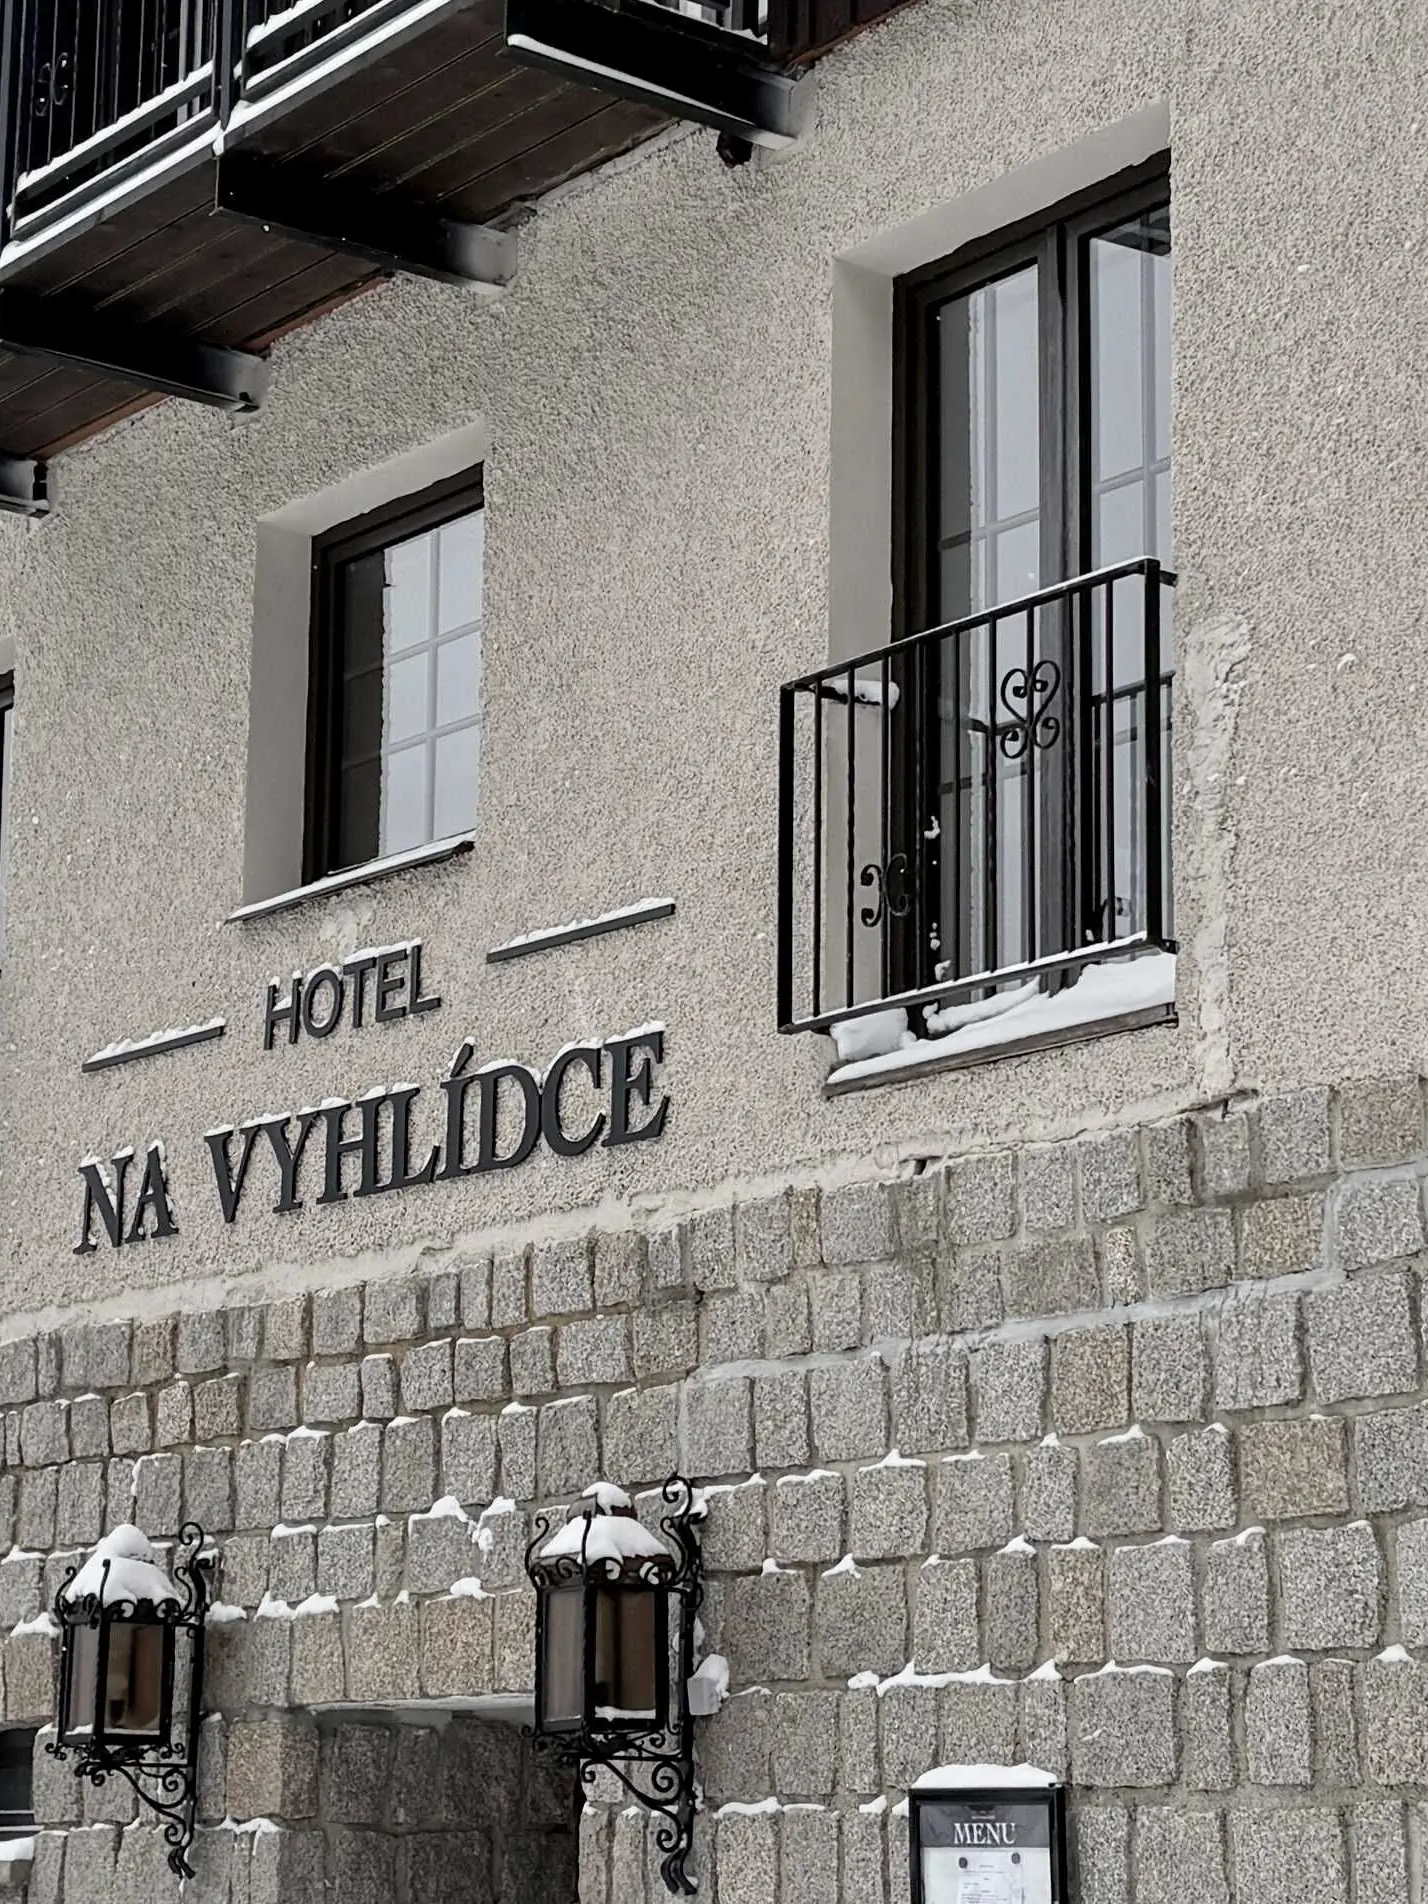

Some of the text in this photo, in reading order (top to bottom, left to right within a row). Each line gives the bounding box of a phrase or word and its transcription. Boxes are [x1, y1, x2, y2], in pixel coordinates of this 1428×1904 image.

[264, 943, 441, 1050] HOTEL
[73, 1030, 671, 1255] NA VYHLÍDCE
[953, 1822, 1016, 1845] MENU
